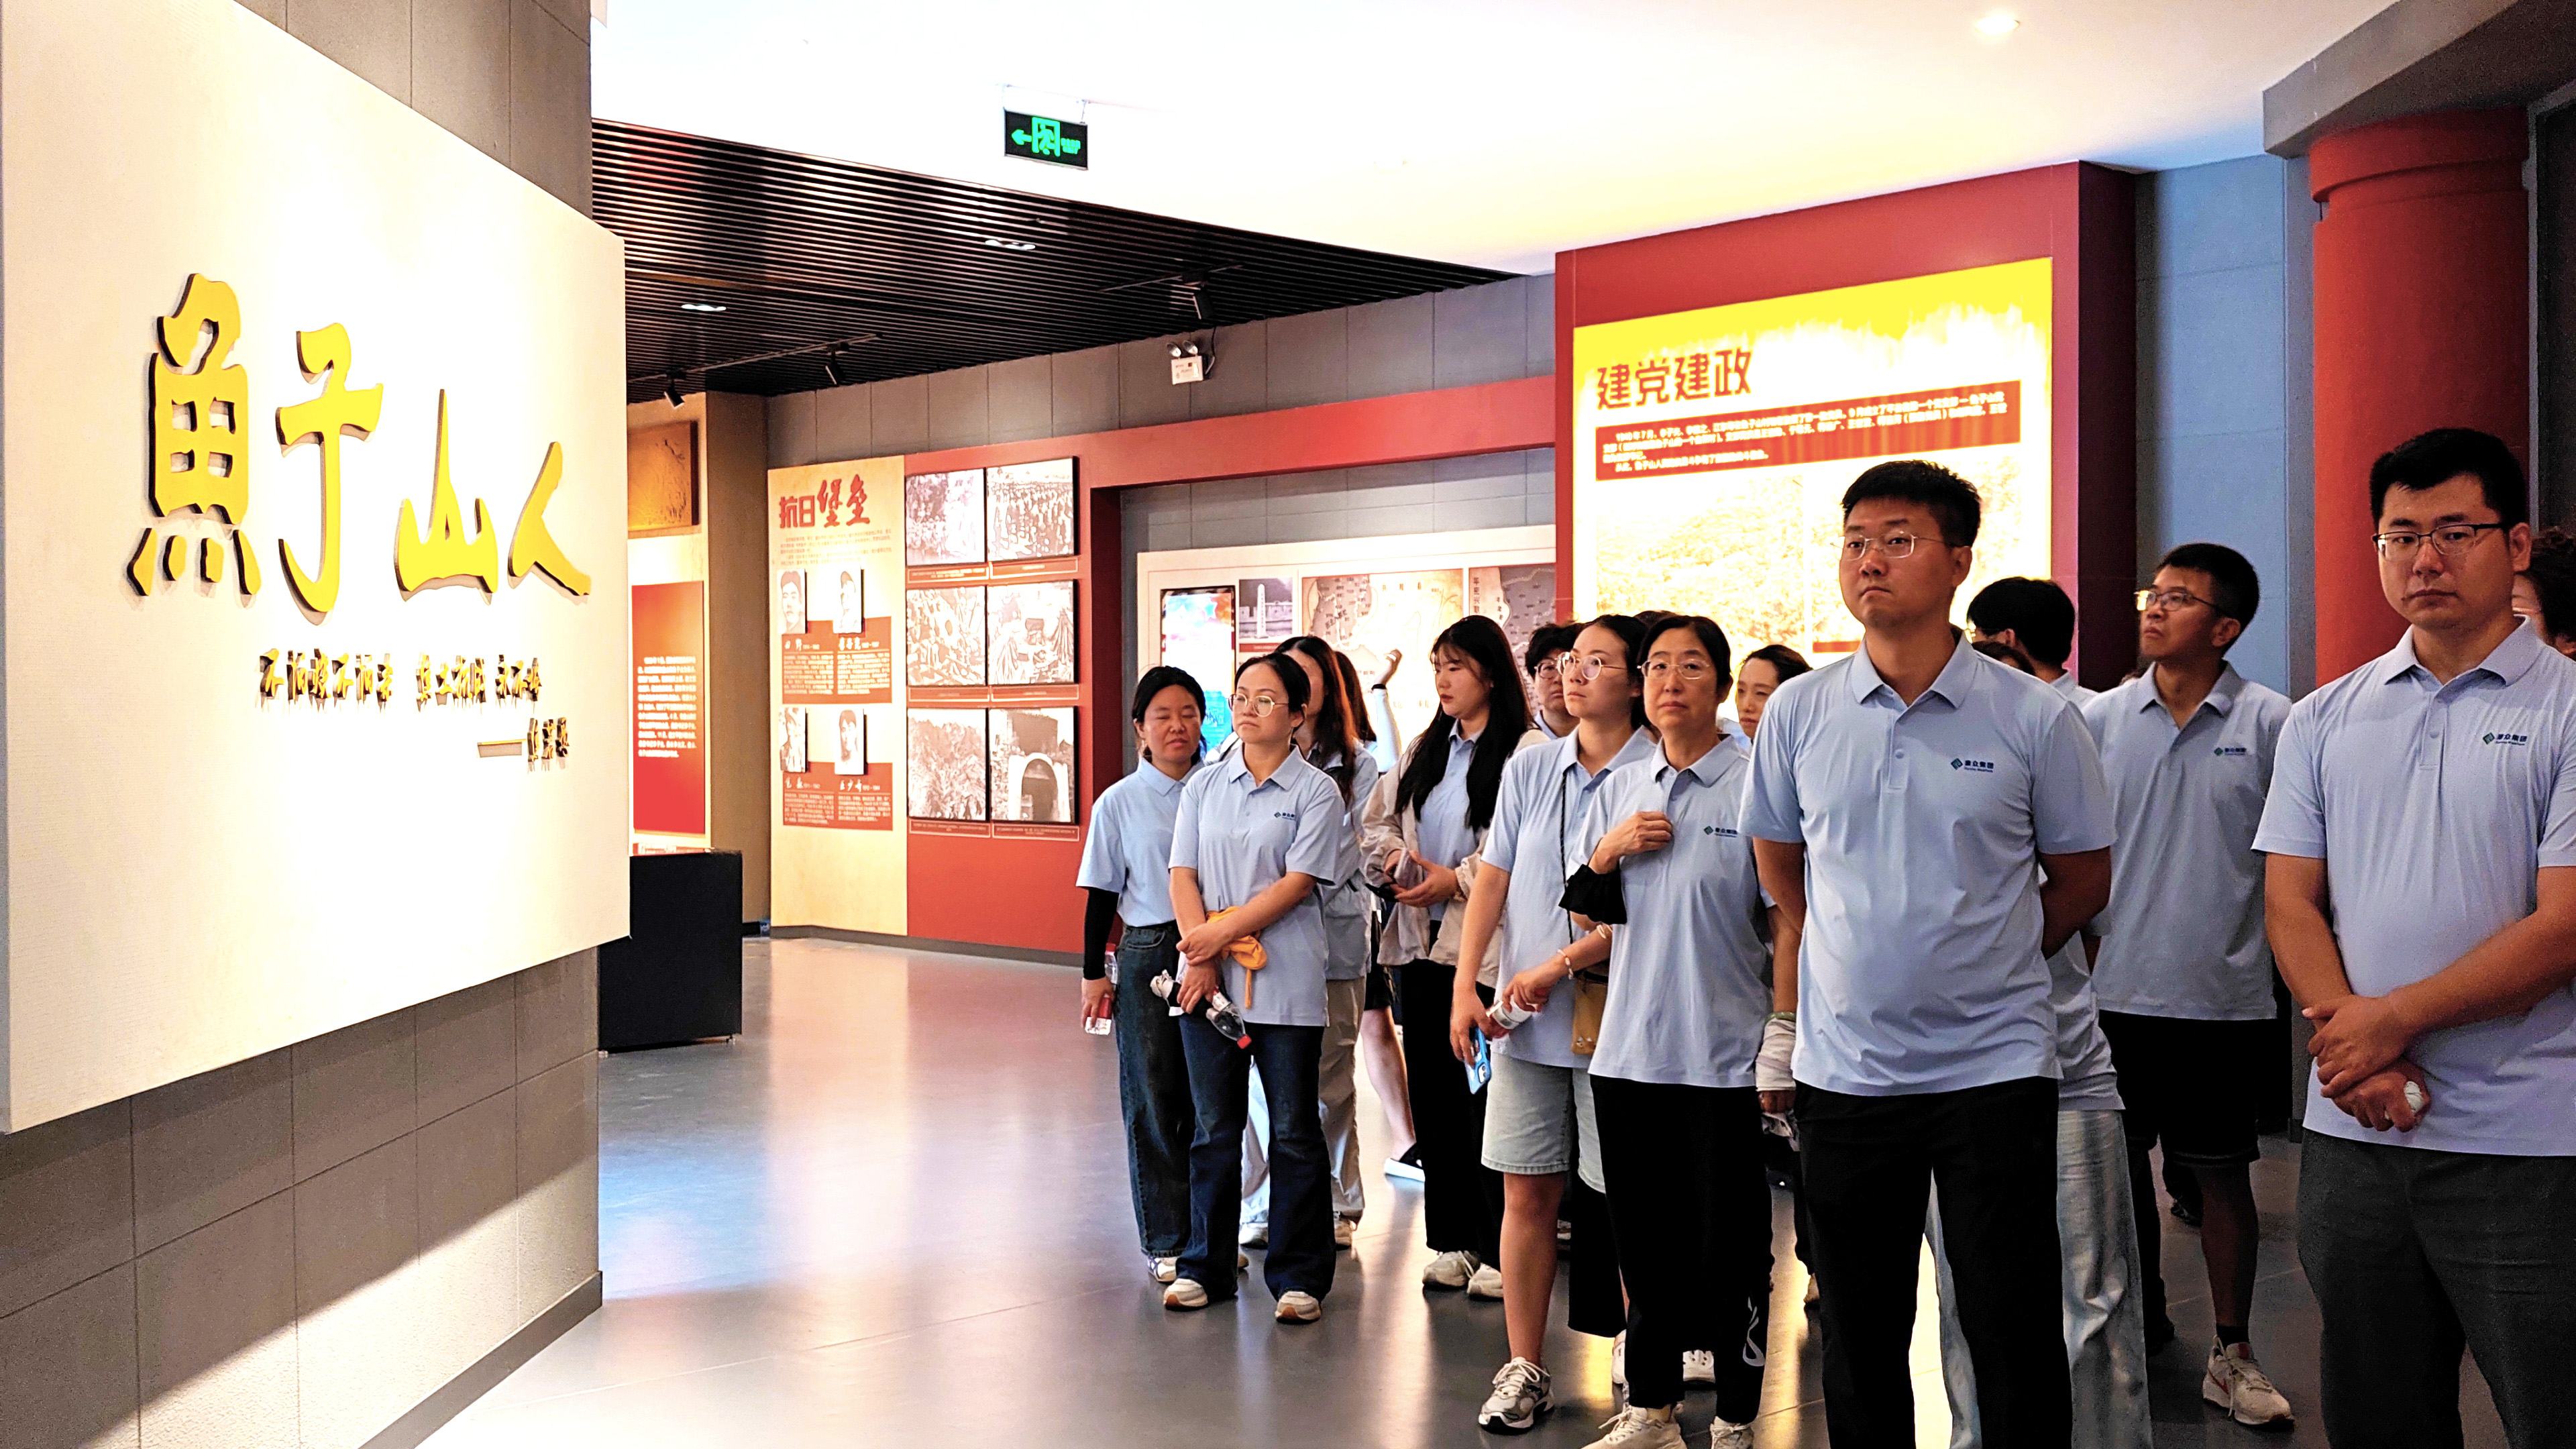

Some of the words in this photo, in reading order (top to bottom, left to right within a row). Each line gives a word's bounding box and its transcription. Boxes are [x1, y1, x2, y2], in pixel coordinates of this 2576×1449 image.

[1597, 347, 1752, 410] 建党建政
[779, 474, 871, 528] 抗日堡垒
